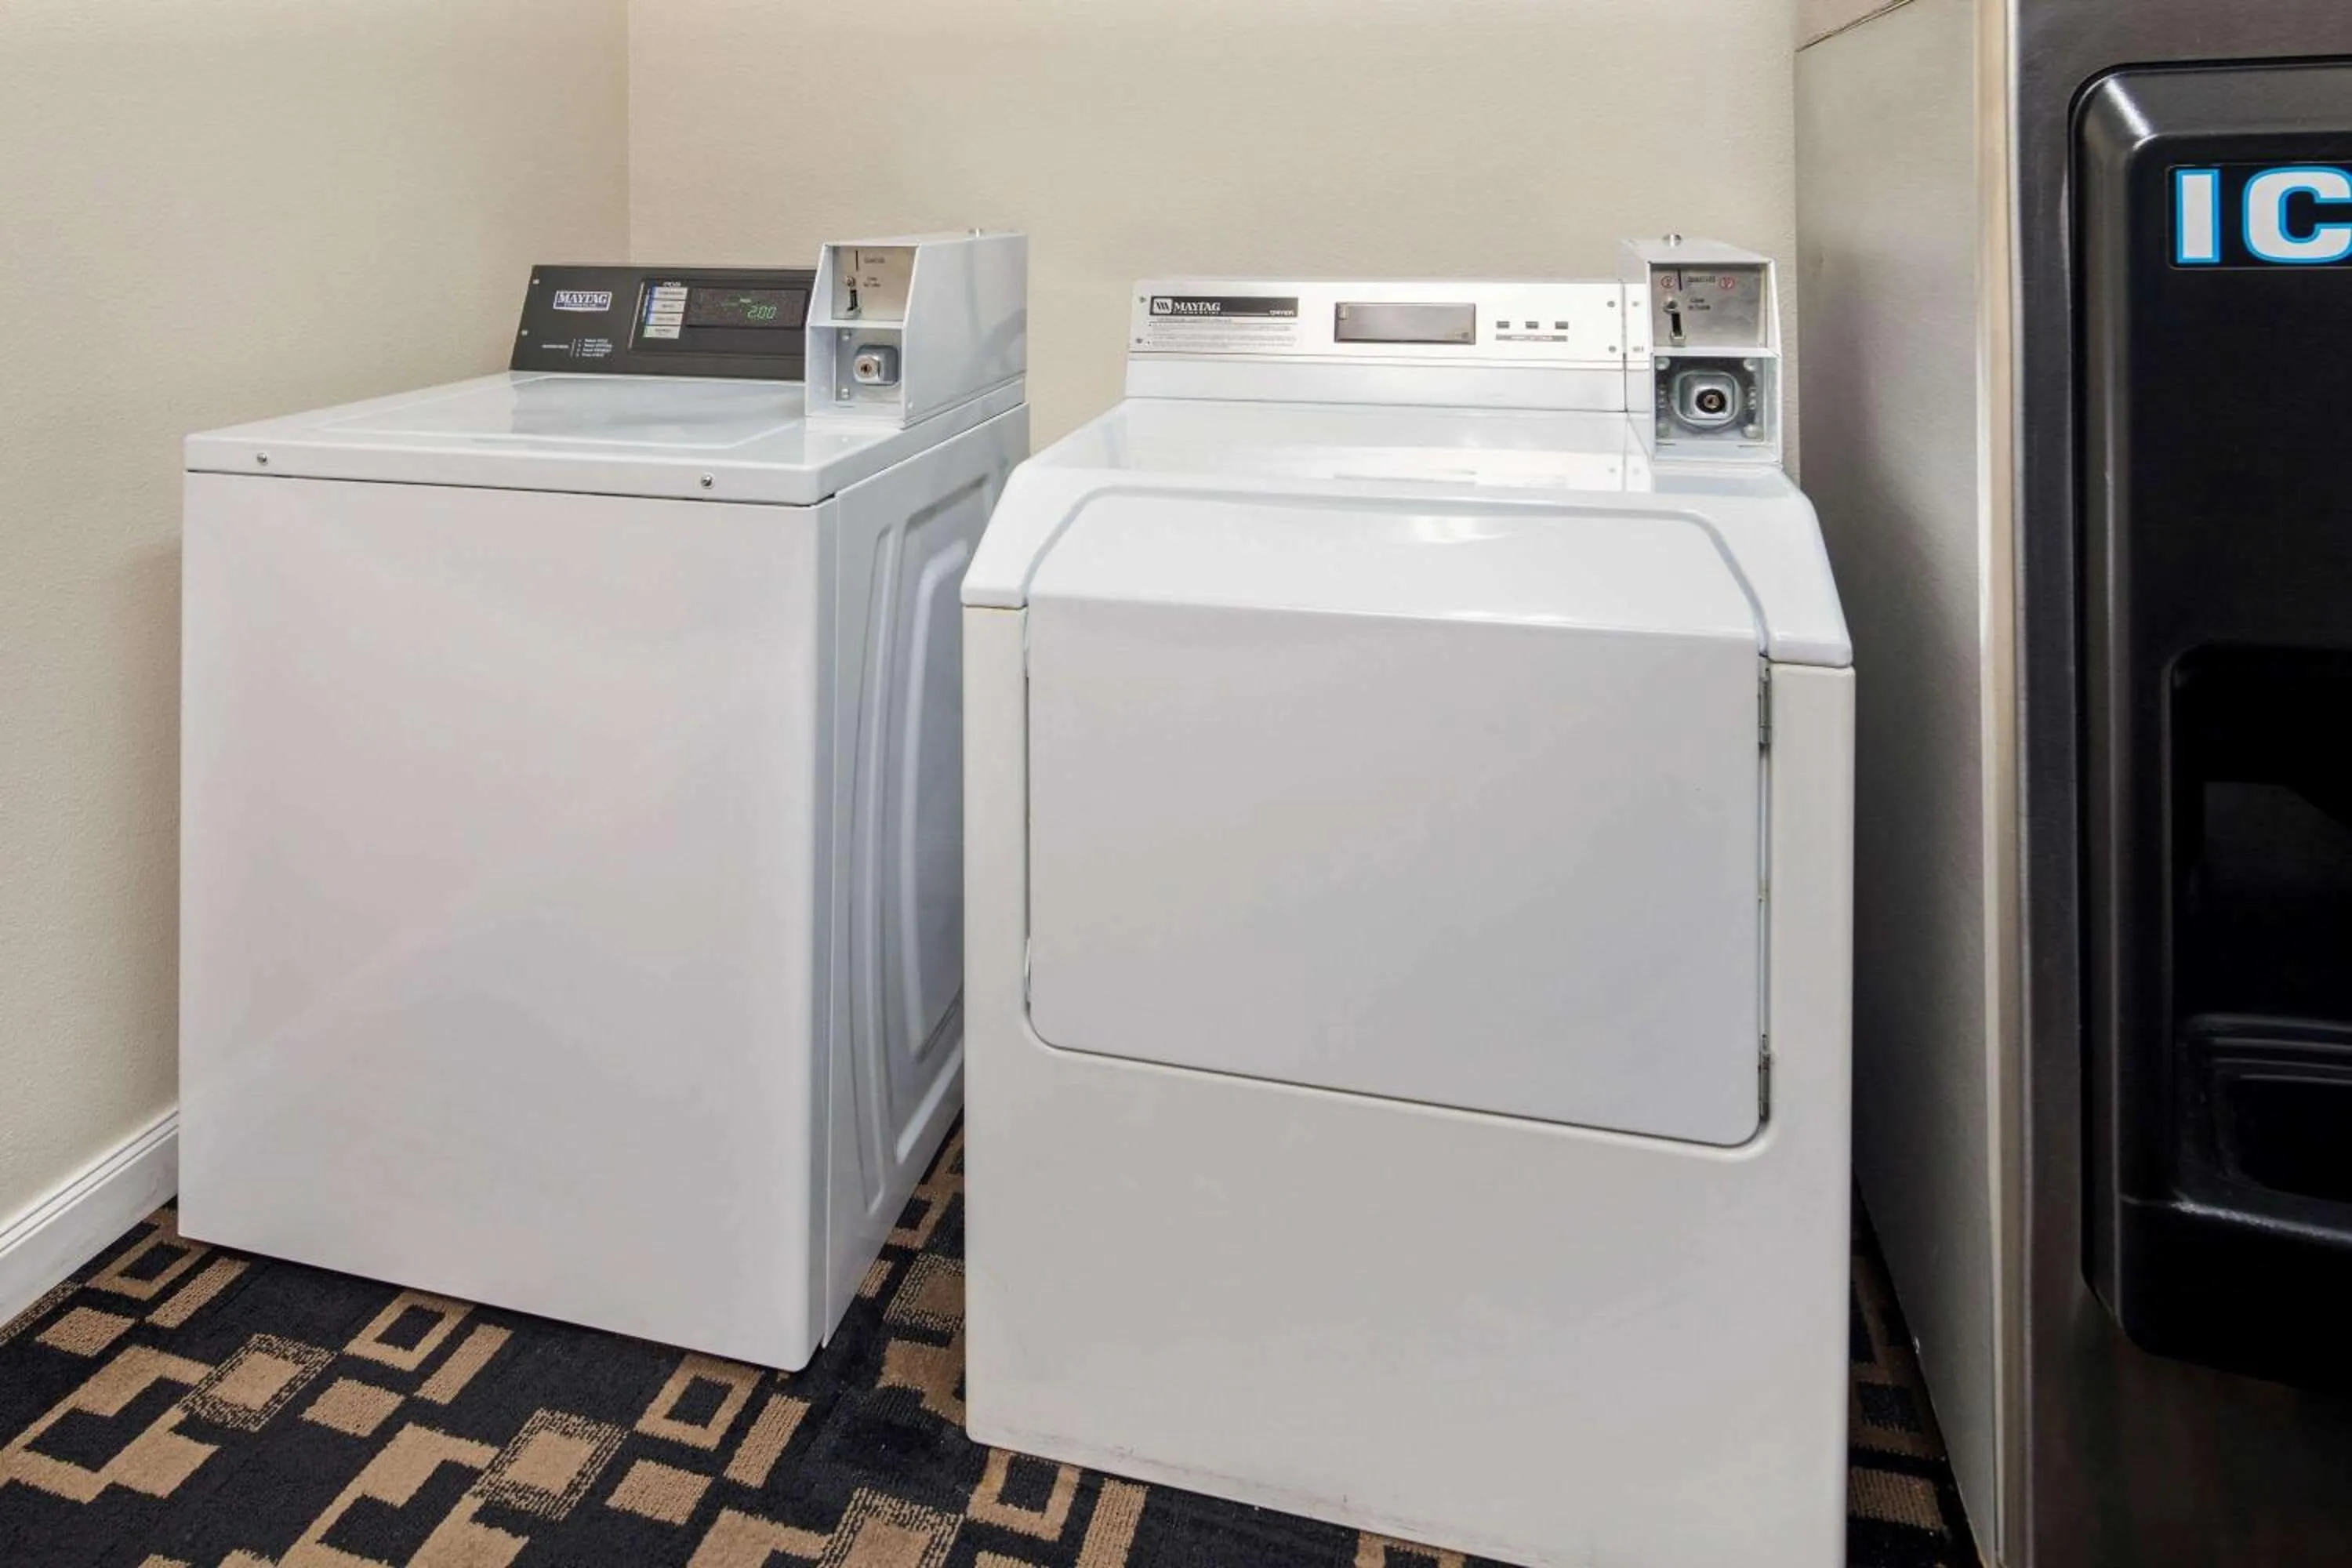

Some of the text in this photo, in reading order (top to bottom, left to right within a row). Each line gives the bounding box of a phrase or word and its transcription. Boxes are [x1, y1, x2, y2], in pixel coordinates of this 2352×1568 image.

[2176, 166, 2352, 264] IC
[557, 294, 608, 304] MAYTAG
[1173, 301, 1221, 311] MAYTAG
